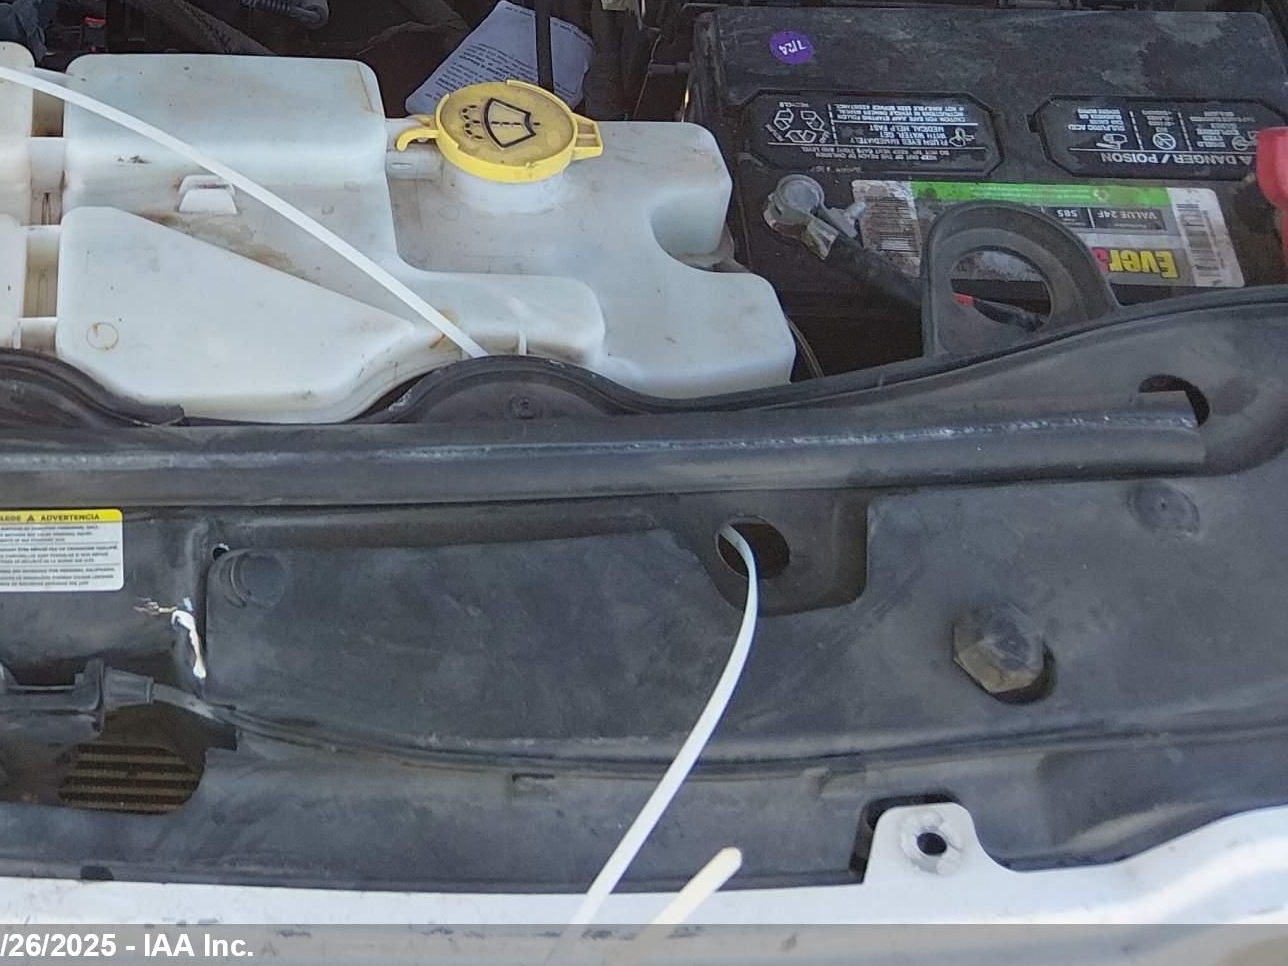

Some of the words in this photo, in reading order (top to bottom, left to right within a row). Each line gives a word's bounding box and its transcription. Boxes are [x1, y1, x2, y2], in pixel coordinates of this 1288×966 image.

[869, 124, 889, 132] FAST
[911, 125, 945, 133] MEDICAL
[849, 136, 900, 145] IMMEDIATELY
[901, 138, 921, 147] EYES
[923, 138, 949, 147] FLUSH
[1100, 152, 1159, 164] POISON
[1173, 153, 1237, 165] DANGER
[1095, 209, 1118, 219] 24F
[1119, 210, 1158, 220] VALUE
[40, 513, 100, 522] ADVERTENCIA
